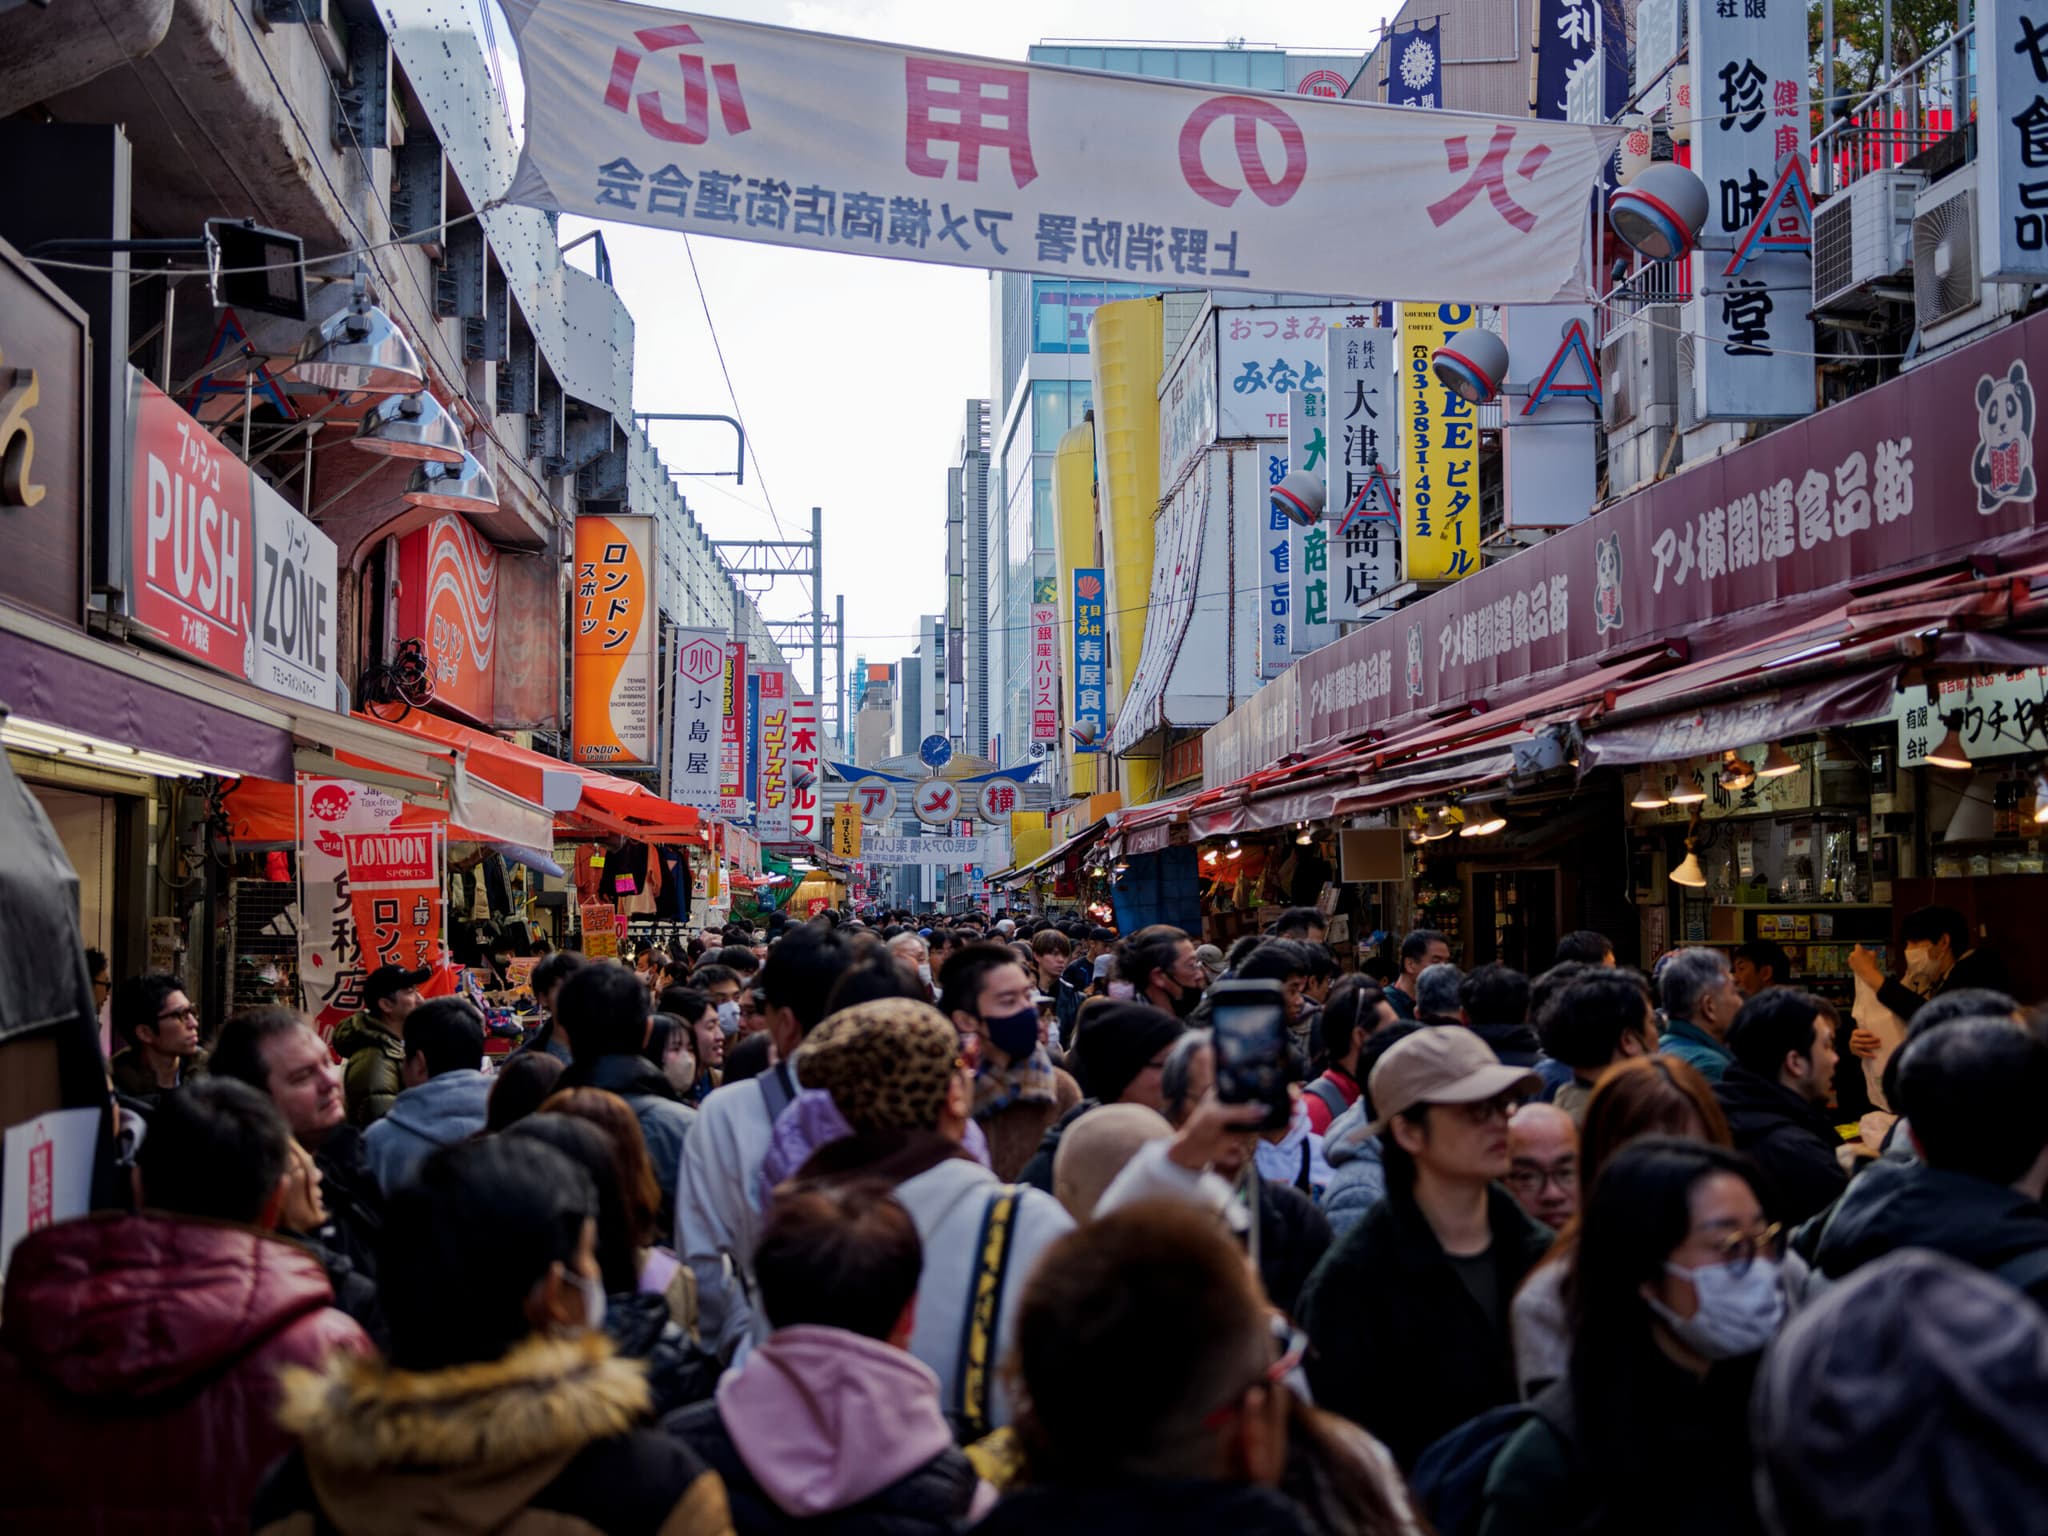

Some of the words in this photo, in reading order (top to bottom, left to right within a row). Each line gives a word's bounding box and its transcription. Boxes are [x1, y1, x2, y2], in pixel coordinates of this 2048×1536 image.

[1718, 58, 1774, 357] 珍味堂
[1230, 316, 1327, 341] おつまみ
[177, 421, 220, 493] プッシュ
[1411, 358, 1432, 537] 03-3831-4012
[147, 451, 241, 626] PUSH
[1446, 460, 1475, 577] ビタール
[1651, 436, 1915, 594] アメ横開運食品街
[286, 517, 310, 564] ゾーン
[263, 542, 328, 673] ZONE
[579, 563, 598, 635] スポーツ
[602, 543, 630, 650] ロンドン
[1078, 605, 1090, 636] するめ
[433, 612, 465, 662] ロンドン
[1438, 573, 1569, 673] アメ横開運食品街
[686, 689, 712, 775] 小島屋
[1906, 706, 1928, 729] 有限
[579, 744, 621, 754] LONDON
[1906, 737, 1928, 760] 会社
[360, 797, 398, 808] Tax-free
[374, 807, 397, 818] Shop
[859, 786, 1016, 816] アメ横
[348, 836, 428, 867] LONDON
[385, 868, 426, 878] SPORTS
